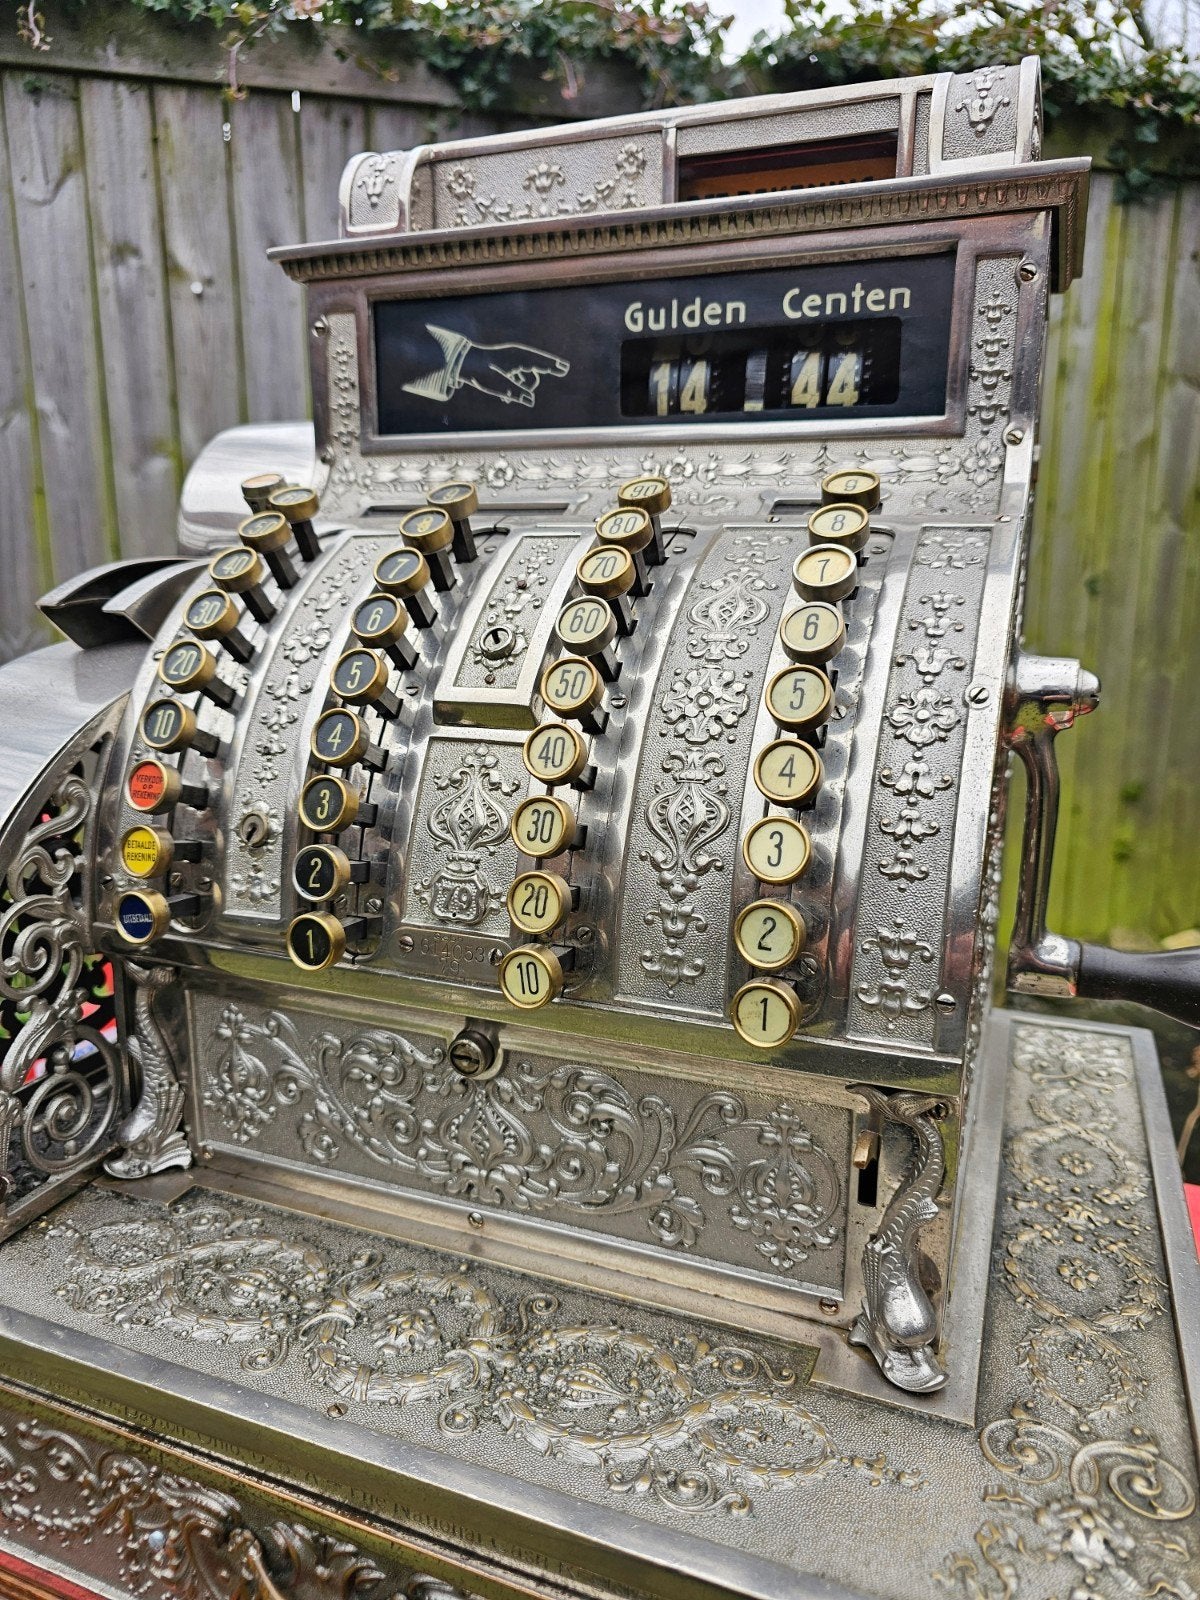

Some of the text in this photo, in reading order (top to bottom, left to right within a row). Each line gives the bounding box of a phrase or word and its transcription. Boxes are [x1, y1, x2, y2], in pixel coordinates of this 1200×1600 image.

[624, 282, 911, 333] Gulden Centen
[653, 351, 860, 416] 14 44
[630, 484, 661, 498] 90
[844, 478, 860, 492] 9
[608, 516, 638, 535] 80
[831, 514, 846, 533] 8
[222, 555, 250, 576] 40
[388, 557, 410, 579] 7
[587, 555, 617, 579] 70
[818, 558, 832, 582] 7
[193, 599, 222, 625] 30
[366, 606, 381, 631] 6
[570, 607, 600, 634] 60
[803, 612, 820, 641] 6
[170, 649, 197, 676] 20
[346, 661, 361, 690] 5
[555, 668, 586, 700] 50
[790, 677, 806, 711] 5
[153, 708, 175, 739] 10
[327, 723, 342, 751] 4
[537, 735, 565, 769] 40
[779, 754, 796, 788] 4
[317, 789, 331, 820] 3
[526, 808, 555, 844] 30
[126, 851, 156, 862] REKENING
[127, 839, 156, 850] BETAALDE
[767, 830, 783, 866] 3
[308, 857, 323, 888] 2
[521, 882, 548, 919] 20
[305, 929, 314, 959] 1
[758, 915, 776, 951] 2
[516, 960, 540, 996] 10
[759, 997, 769, 1032] 1
